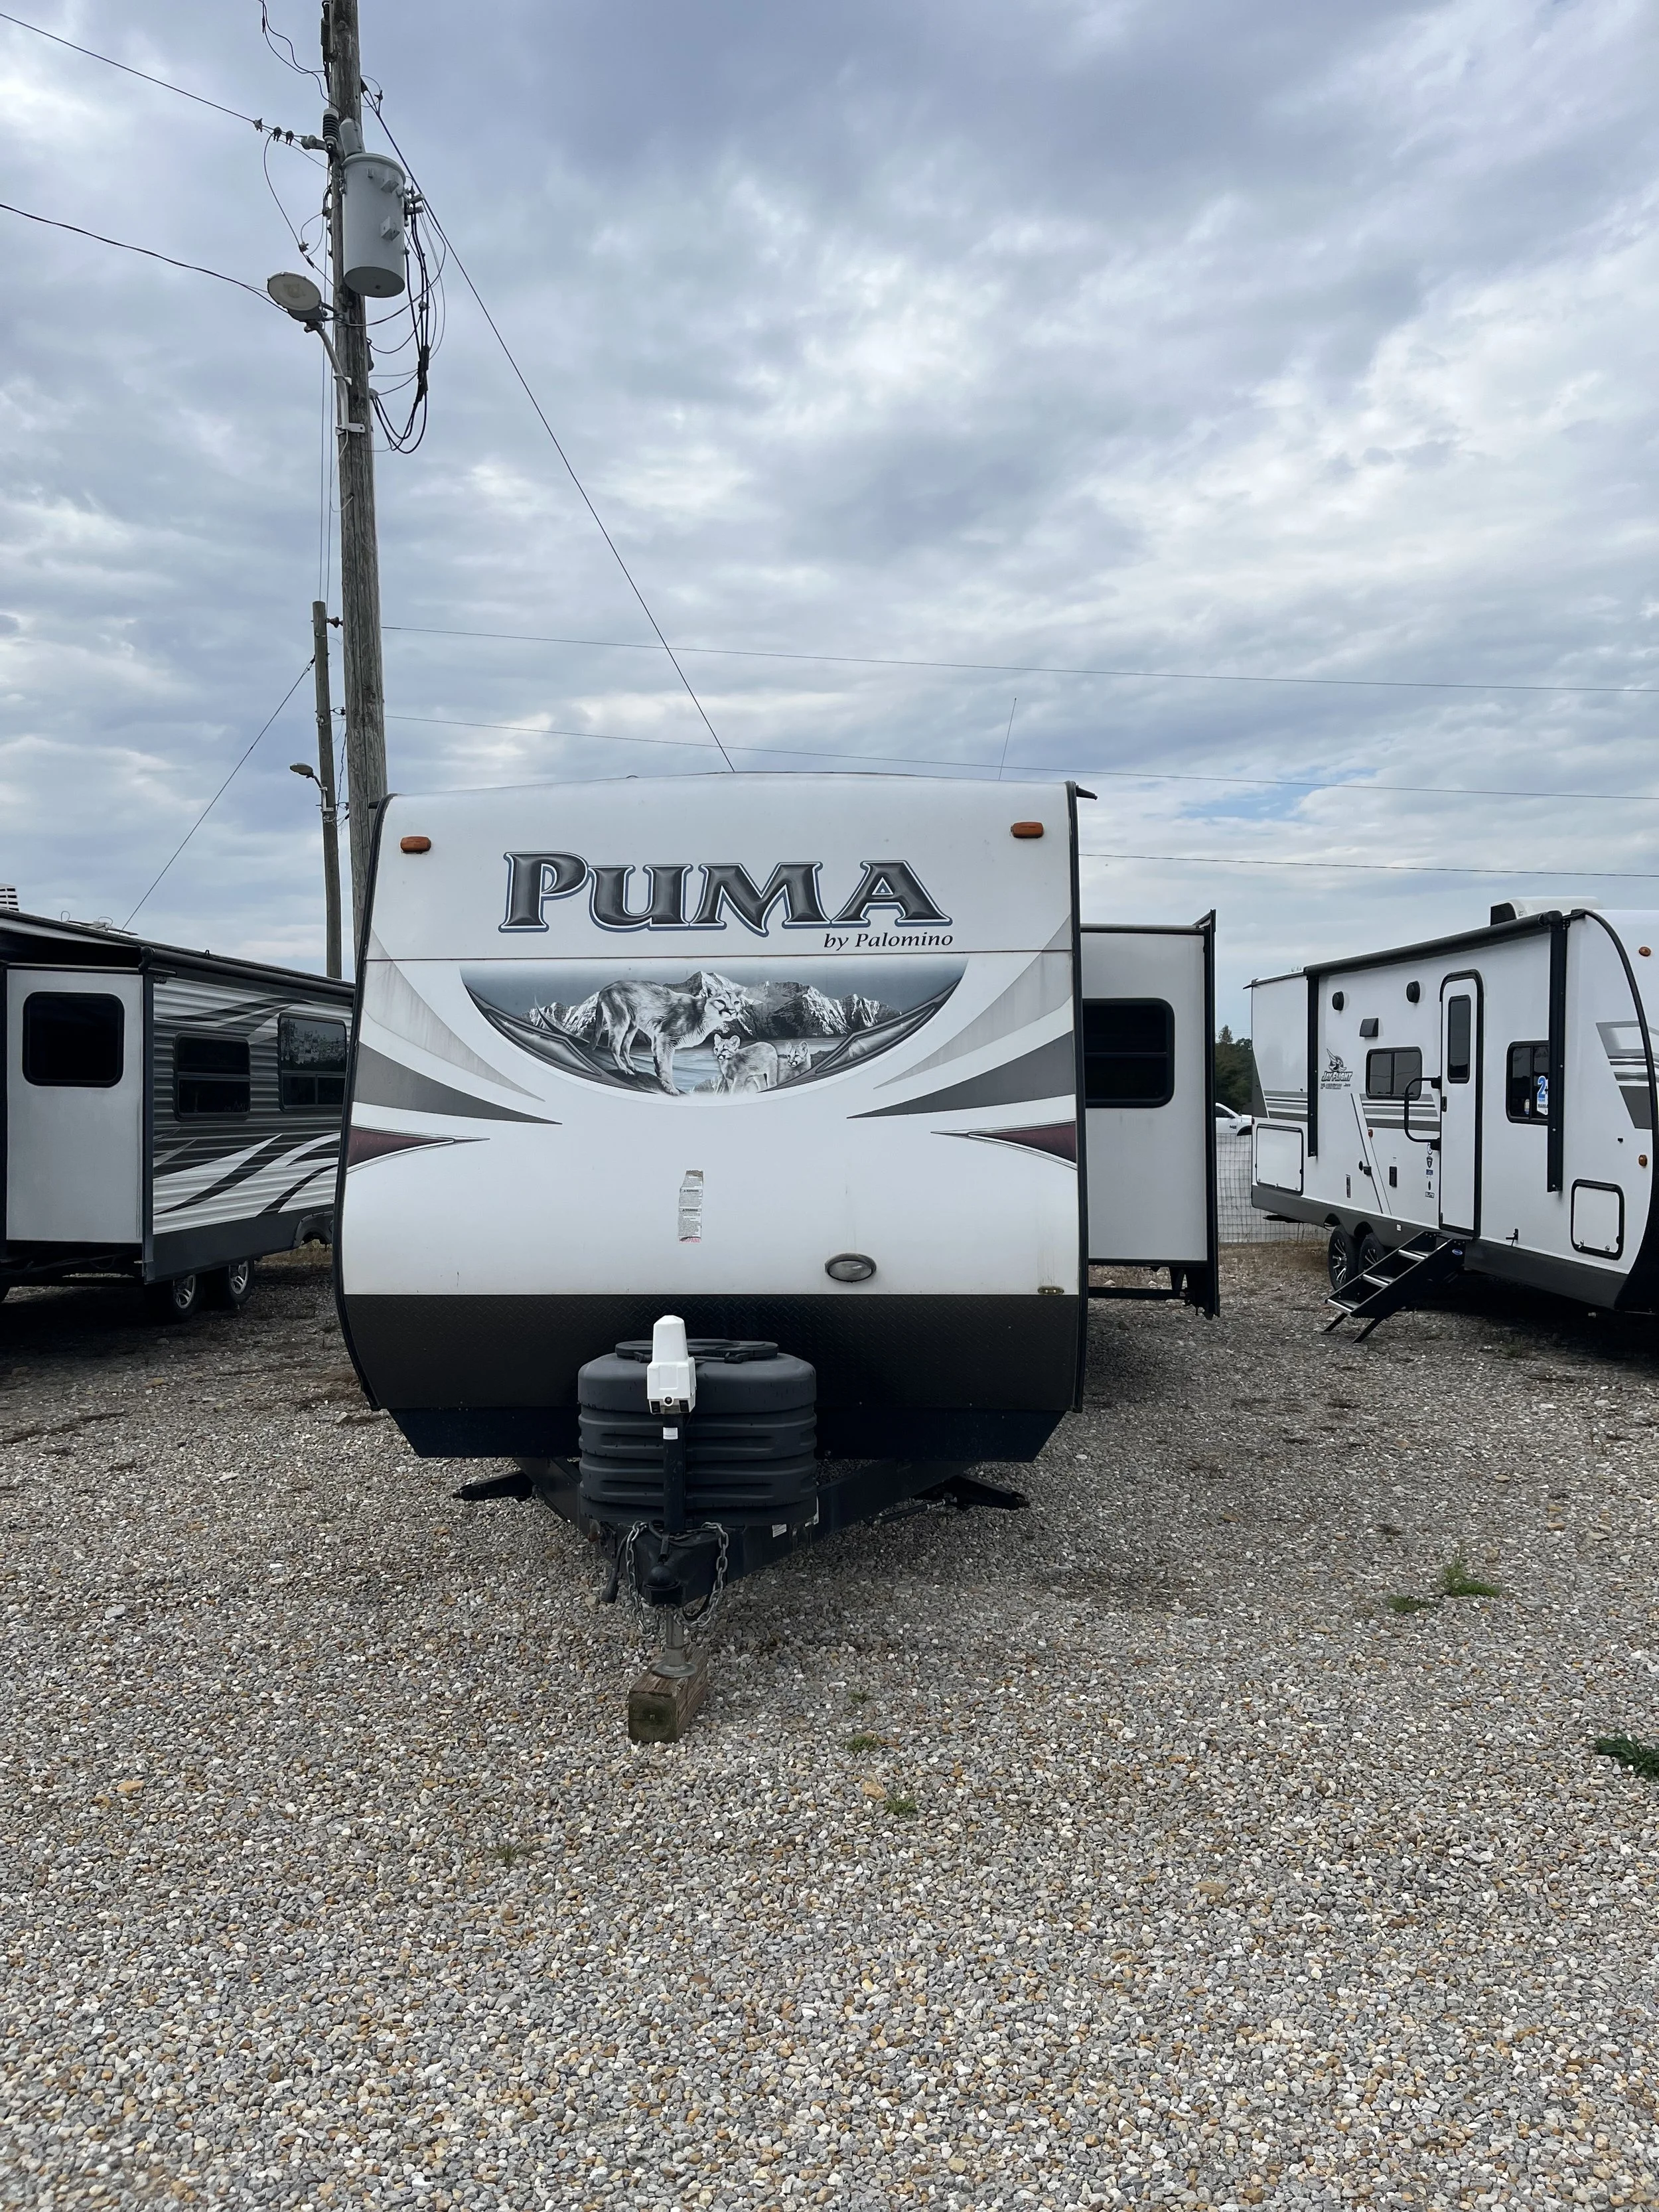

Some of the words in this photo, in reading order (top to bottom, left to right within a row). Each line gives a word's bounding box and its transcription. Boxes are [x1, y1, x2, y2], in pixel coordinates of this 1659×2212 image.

[498, 851, 953, 936] PUMA
[824, 933, 849, 951] by
[855, 932, 954, 948] Palomino
[1321, 1070, 1334, 1082] JAY
[1332, 1070, 1353, 1082] FLIGHT
